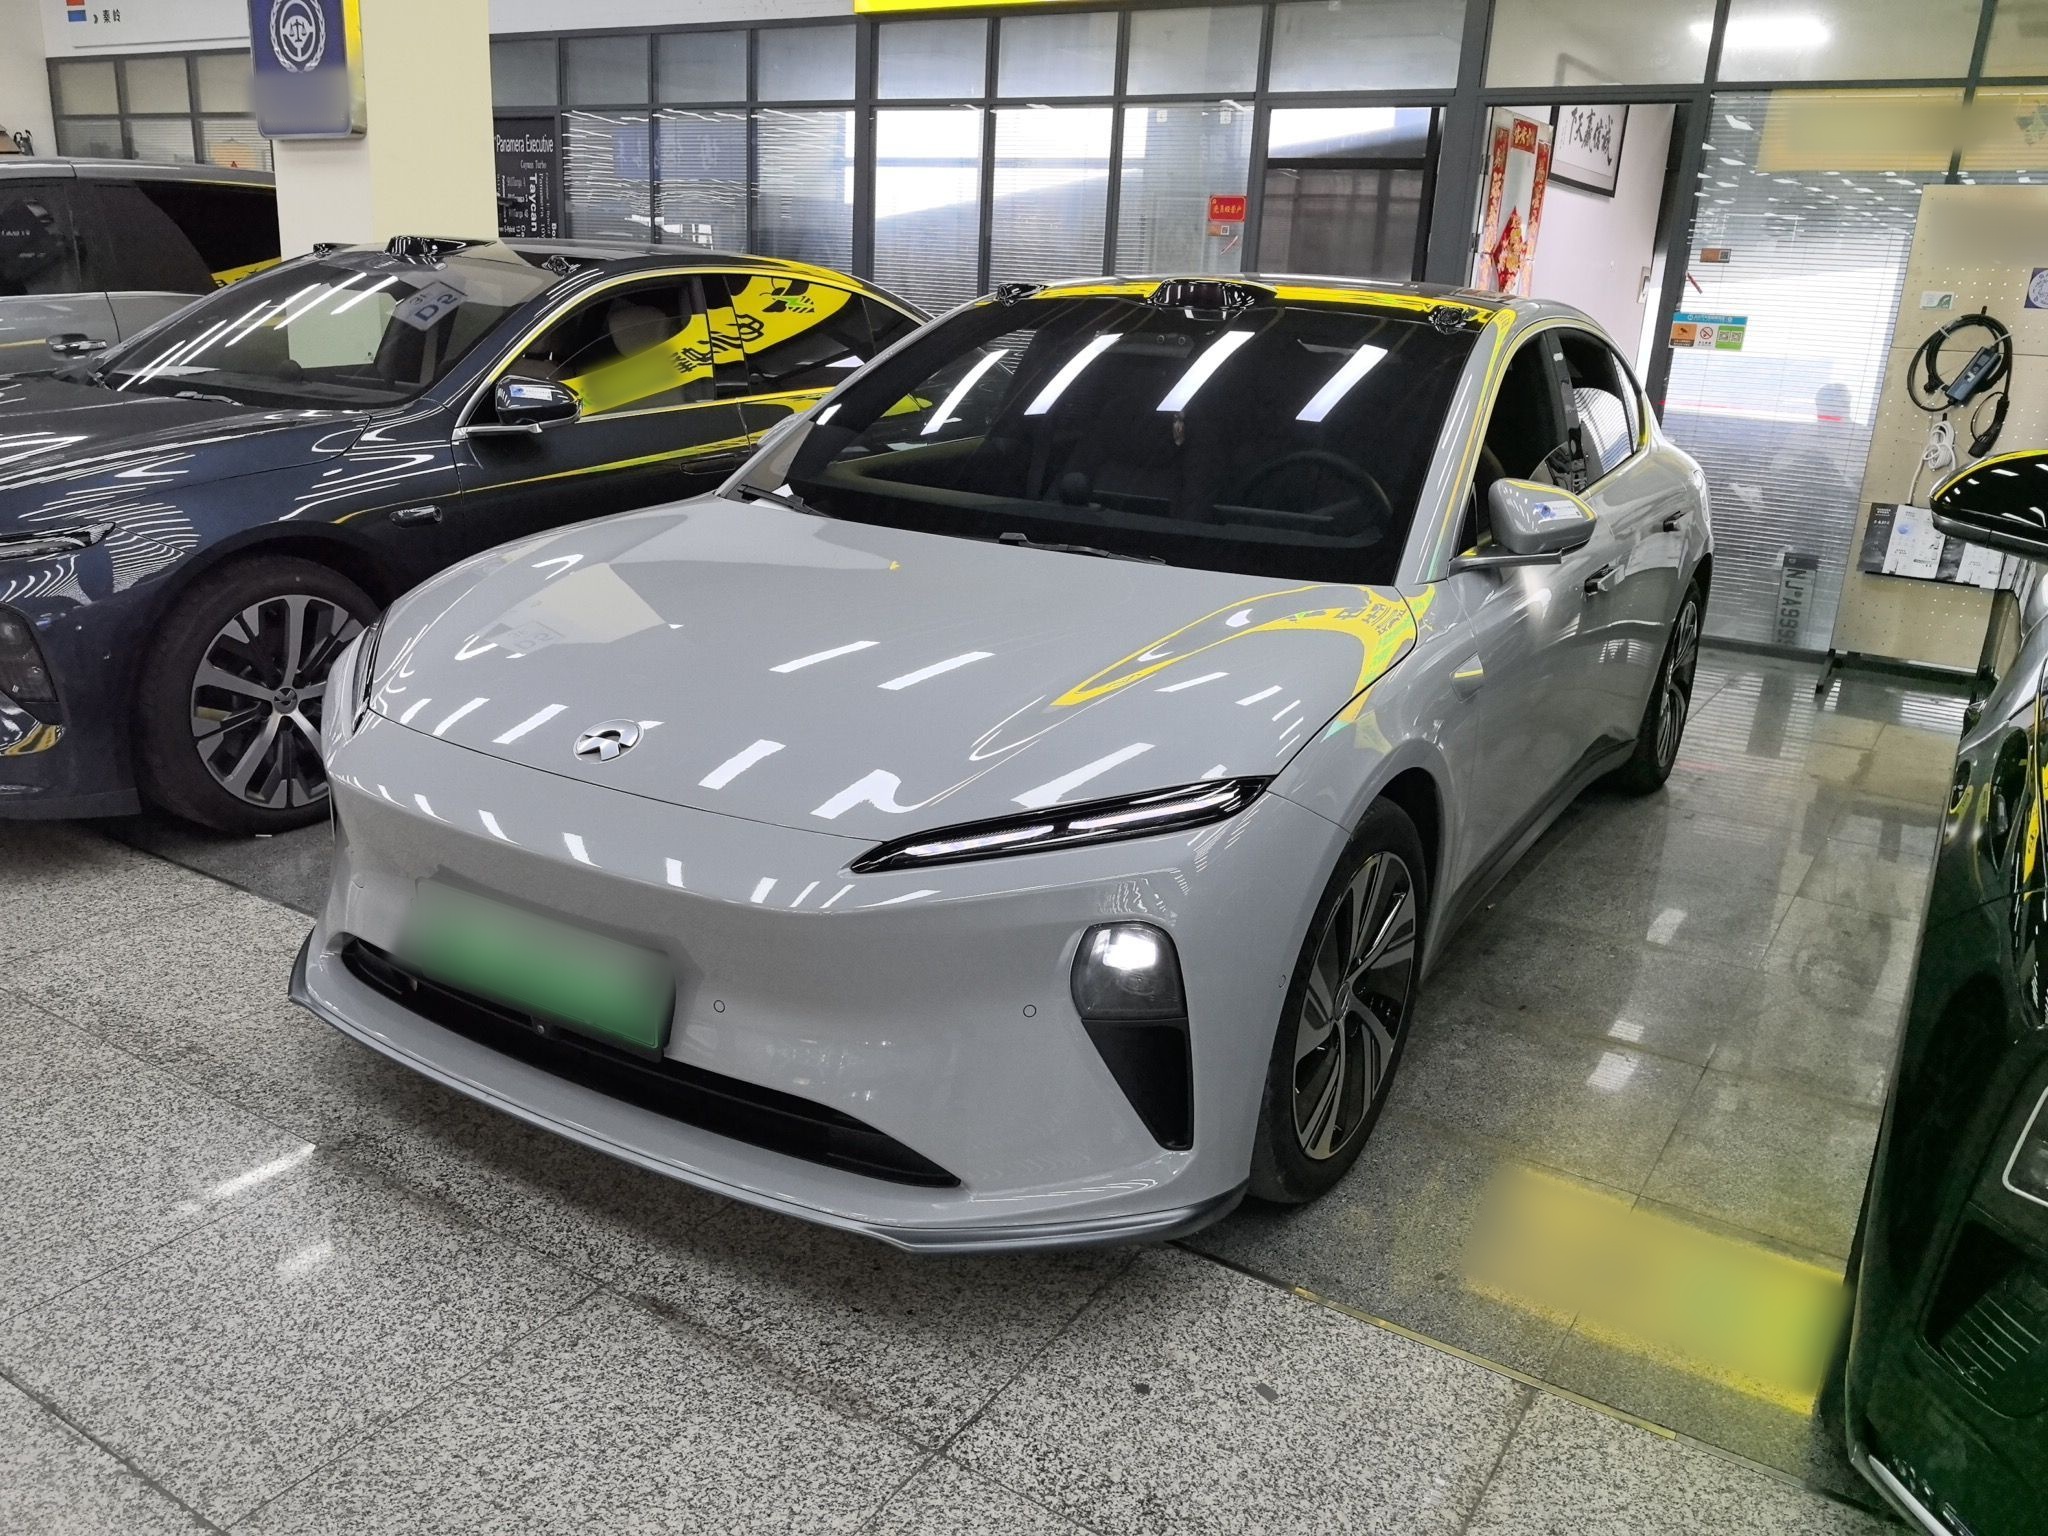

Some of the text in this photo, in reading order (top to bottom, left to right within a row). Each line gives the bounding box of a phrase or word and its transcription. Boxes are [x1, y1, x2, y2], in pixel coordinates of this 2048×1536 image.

[496, 134, 554, 153] Panamera Executive
[528, 172, 538, 232] Taycan
